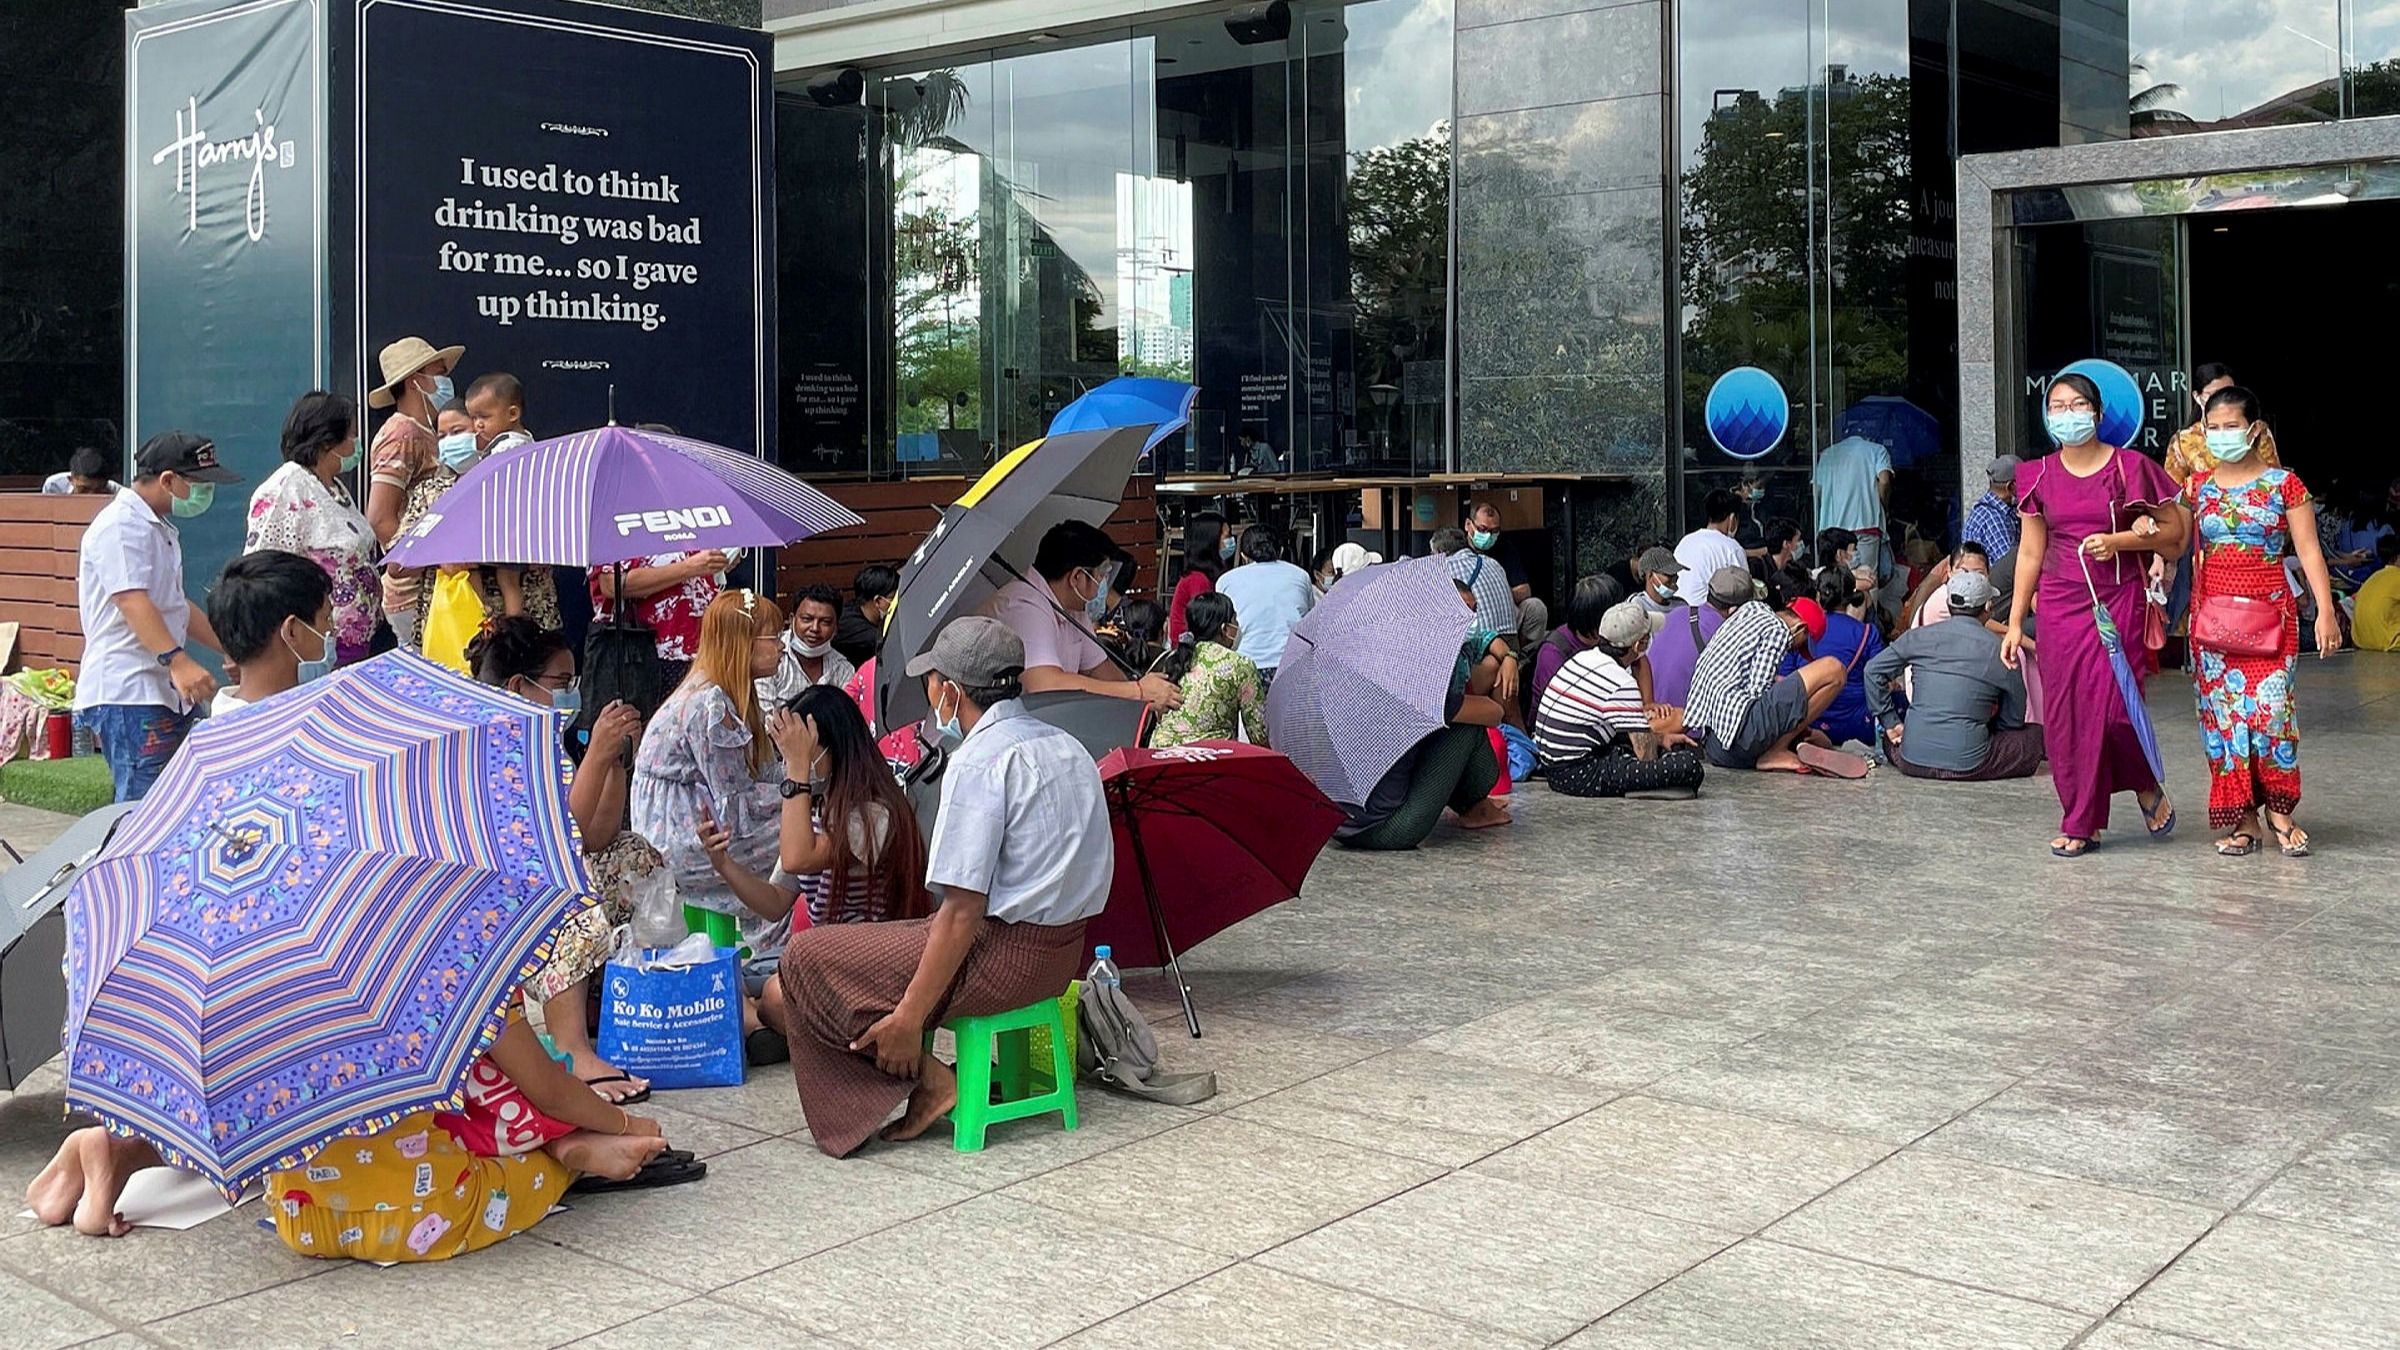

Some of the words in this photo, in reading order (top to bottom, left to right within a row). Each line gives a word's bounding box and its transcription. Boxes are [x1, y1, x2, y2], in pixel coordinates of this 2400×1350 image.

[153, 96, 277, 242] Harry's
[461, 158, 474, 184] I
[480, 164, 558, 191] used
[563, 169, 593, 195] to
[598, 171, 679, 203] think
[435, 198, 579, 244] drinking
[584, 218, 642, 240] was
[647, 215, 701, 244] bad
[439, 242, 489, 272] for
[494, 254, 570, 277] me...
[578, 259, 610, 279] so
[616, 256, 628, 280] I
[633, 262, 697, 290] gave
[477, 296, 520, 325] up
[525, 290, 666, 331] thinking.
[614, 505, 732, 536] FENDI
[663, 532, 697, 541] ROMA
[928, 590, 949, 618] UNDER
[948, 556, 974, 593] ARMOUR
[613, 1000, 636, 1016] Ko
[640, 1003, 663, 1019] Ko
[667, 997, 725, 1019] Mobile
[632, 1019, 662, 1030] Service
[672, 1013, 724, 1029] Accessories
